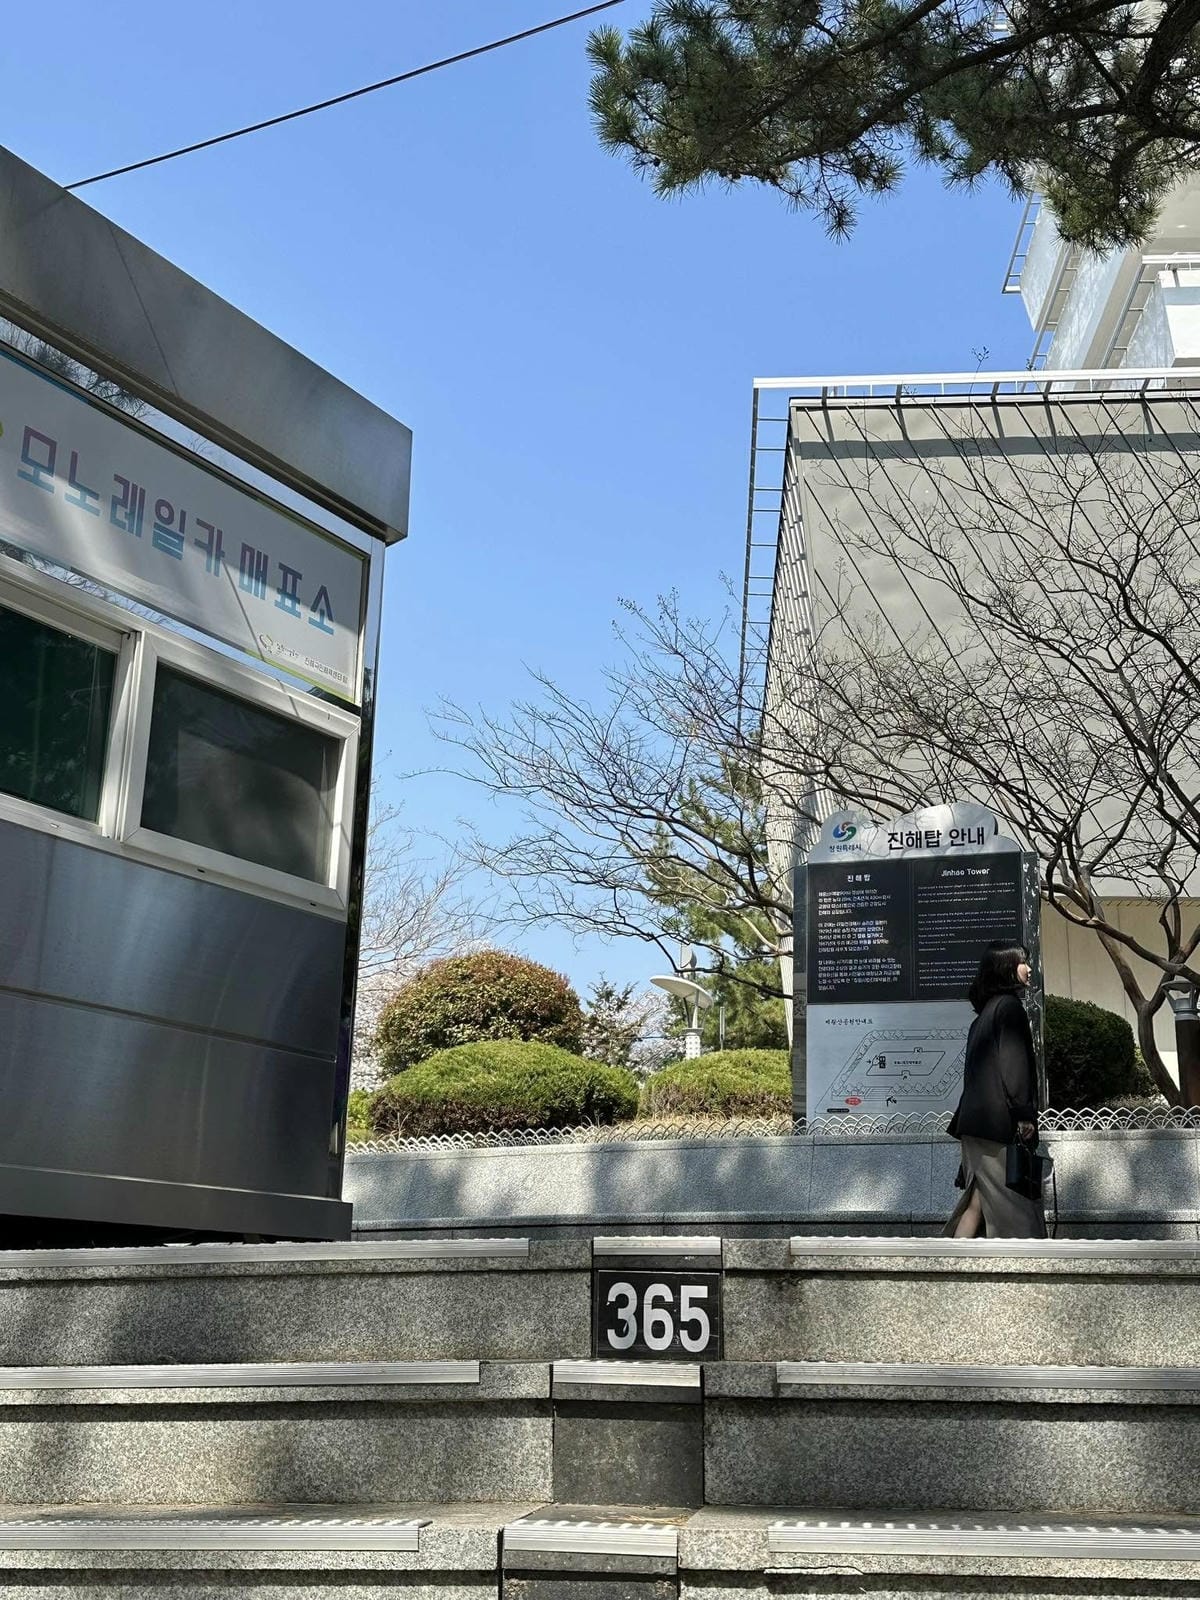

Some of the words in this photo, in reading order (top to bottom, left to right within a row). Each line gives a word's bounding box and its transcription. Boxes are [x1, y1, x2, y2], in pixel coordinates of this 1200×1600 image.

[17, 425, 225, 578] 모노레일카
[239, 541, 335, 637] 매표소
[887, 829, 943, 851] 진해탑
[949, 826, 986, 847] 안내
[966, 867, 990, 876] Tower
[607, 1281, 711, 1353] 365
